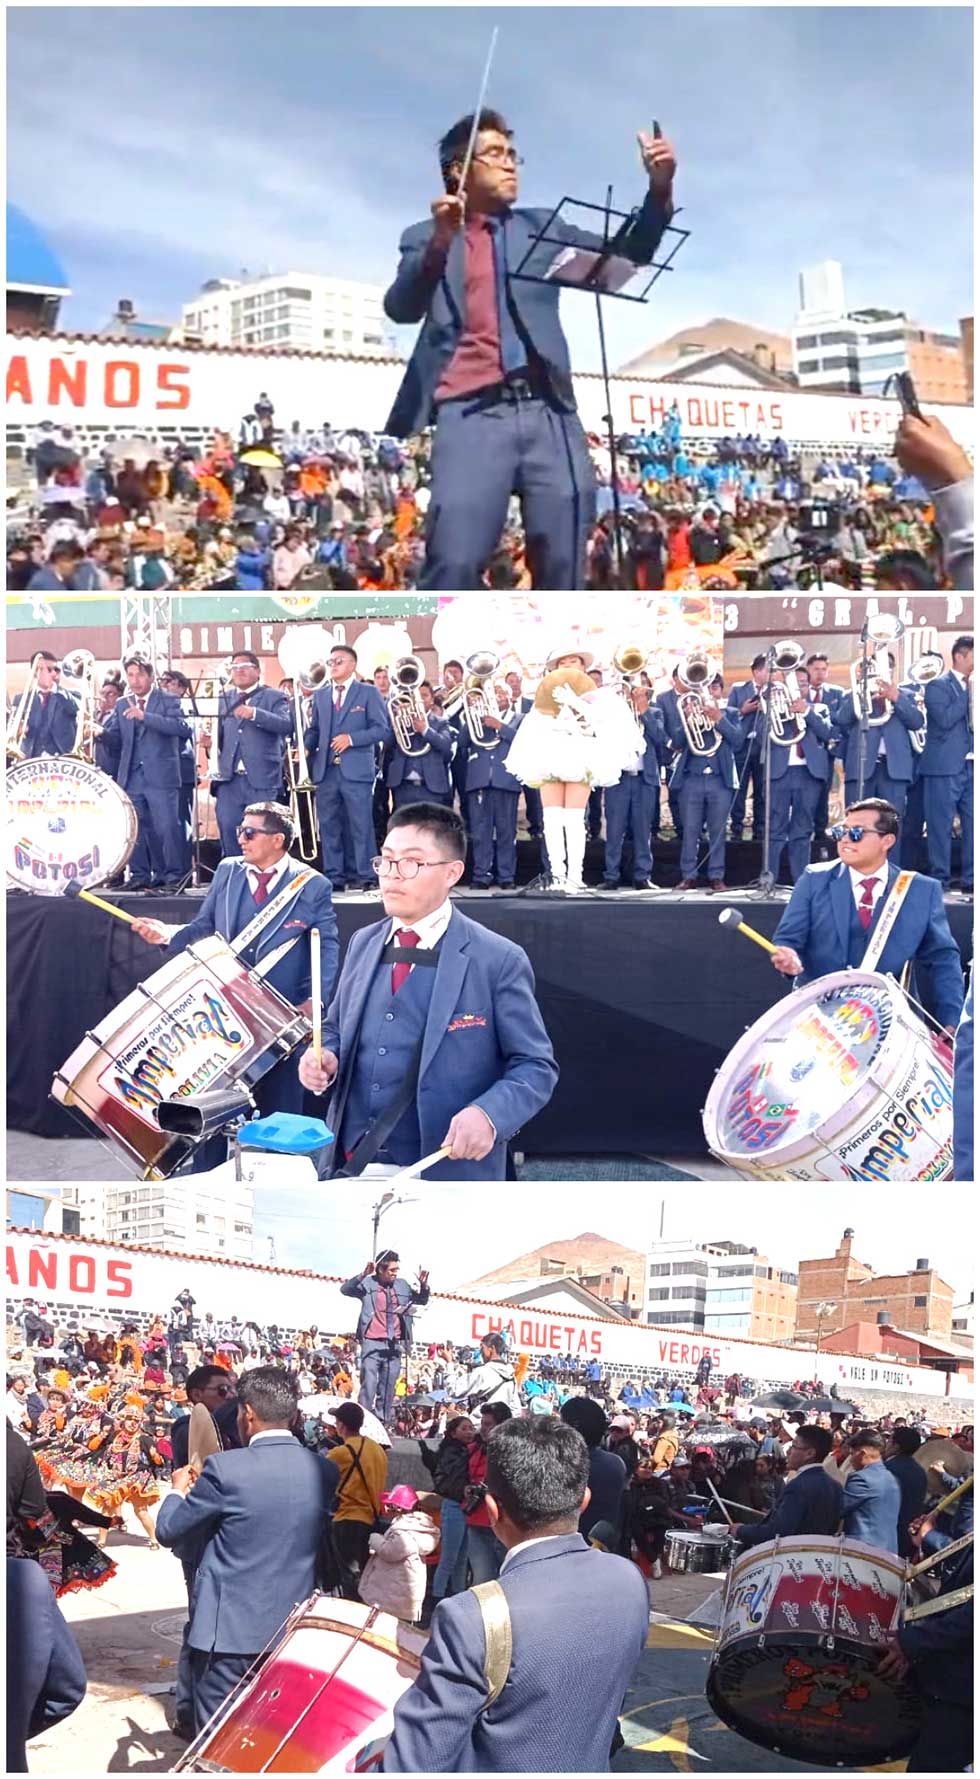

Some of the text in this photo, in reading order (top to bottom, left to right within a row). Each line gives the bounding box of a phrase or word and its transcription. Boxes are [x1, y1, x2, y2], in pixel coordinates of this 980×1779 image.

[6, 351, 191, 410] AÑOS
[848, 410, 905, 434] VERD
[6, 762, 109, 799] NTERNACIONAL
[114, 992, 244, 1112] Imperial
[882, 1101, 898, 1122] por
